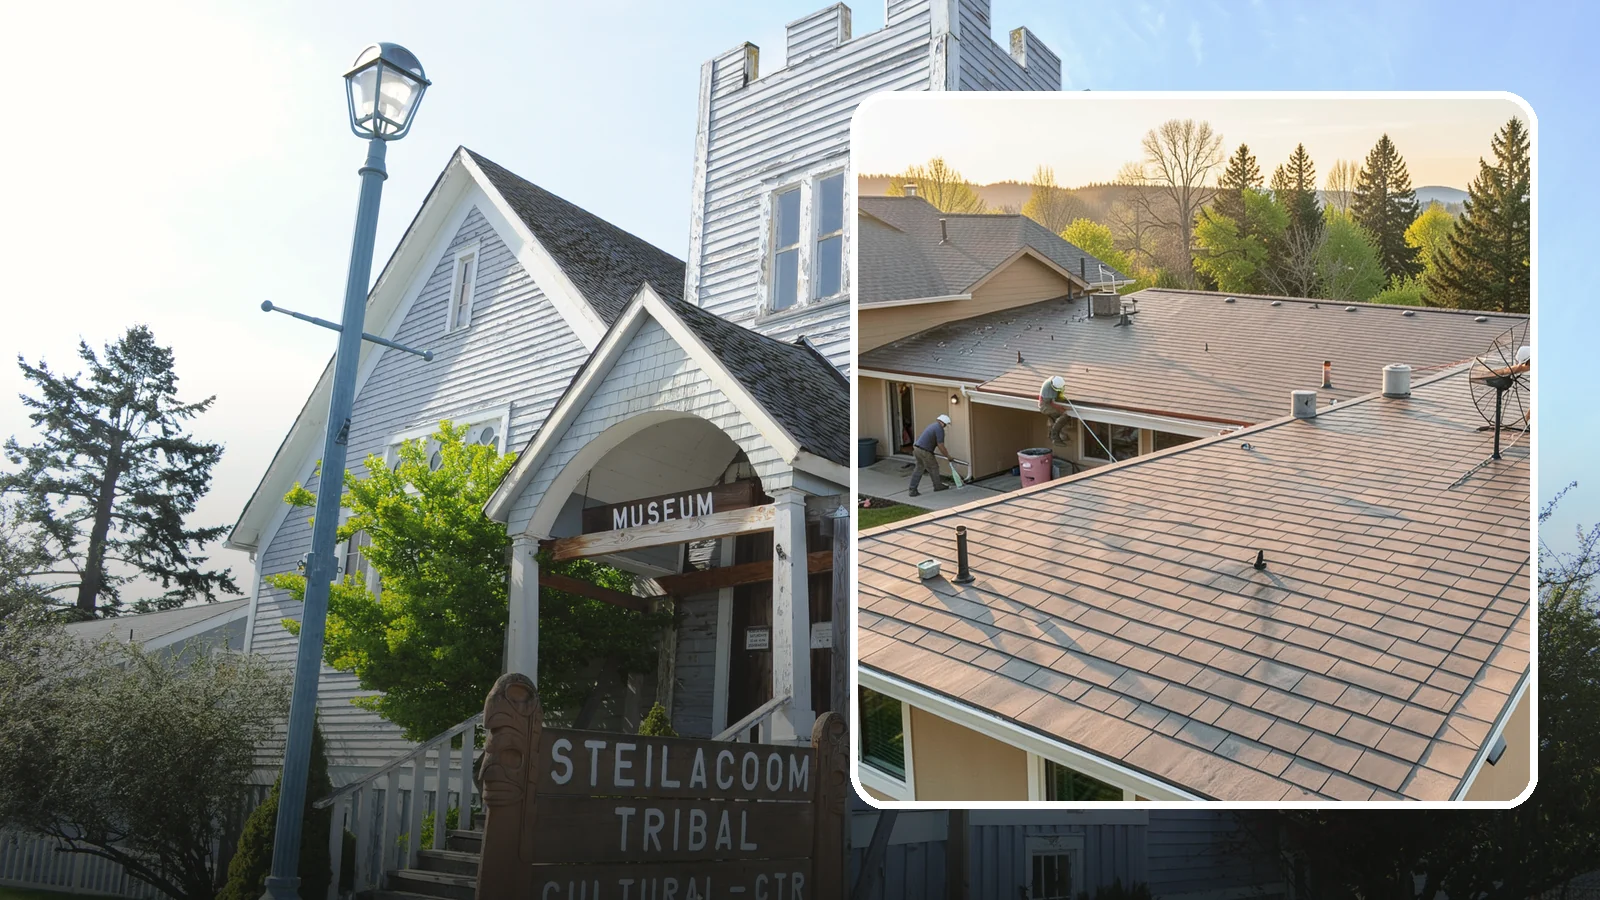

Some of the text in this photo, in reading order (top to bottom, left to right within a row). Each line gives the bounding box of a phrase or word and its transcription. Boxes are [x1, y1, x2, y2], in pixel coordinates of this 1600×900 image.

[613, 491, 713, 530] MUSEUM
[550, 738, 809, 792] STEILACOOM
[615, 807, 757, 852] TRIBAL
